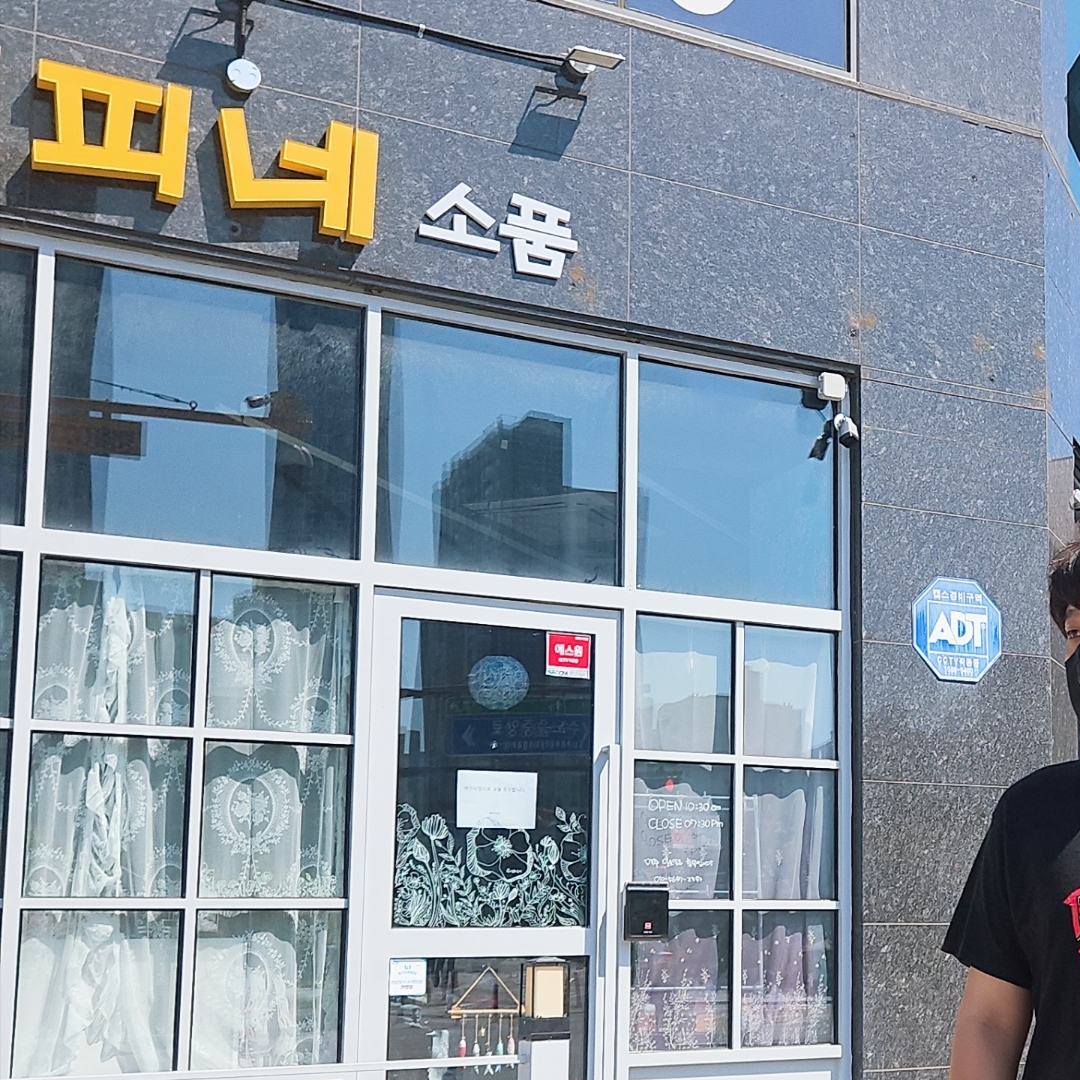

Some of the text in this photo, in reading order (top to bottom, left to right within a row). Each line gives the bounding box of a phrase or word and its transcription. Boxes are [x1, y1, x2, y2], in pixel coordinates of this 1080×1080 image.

[417, 181, 579, 279] 소품
[929, 610, 988, 648] ADT
[554, 643, 584, 658] 에스원
[648, 799, 683, 811] OPEN
[648, 817, 683, 830] CLOSE
